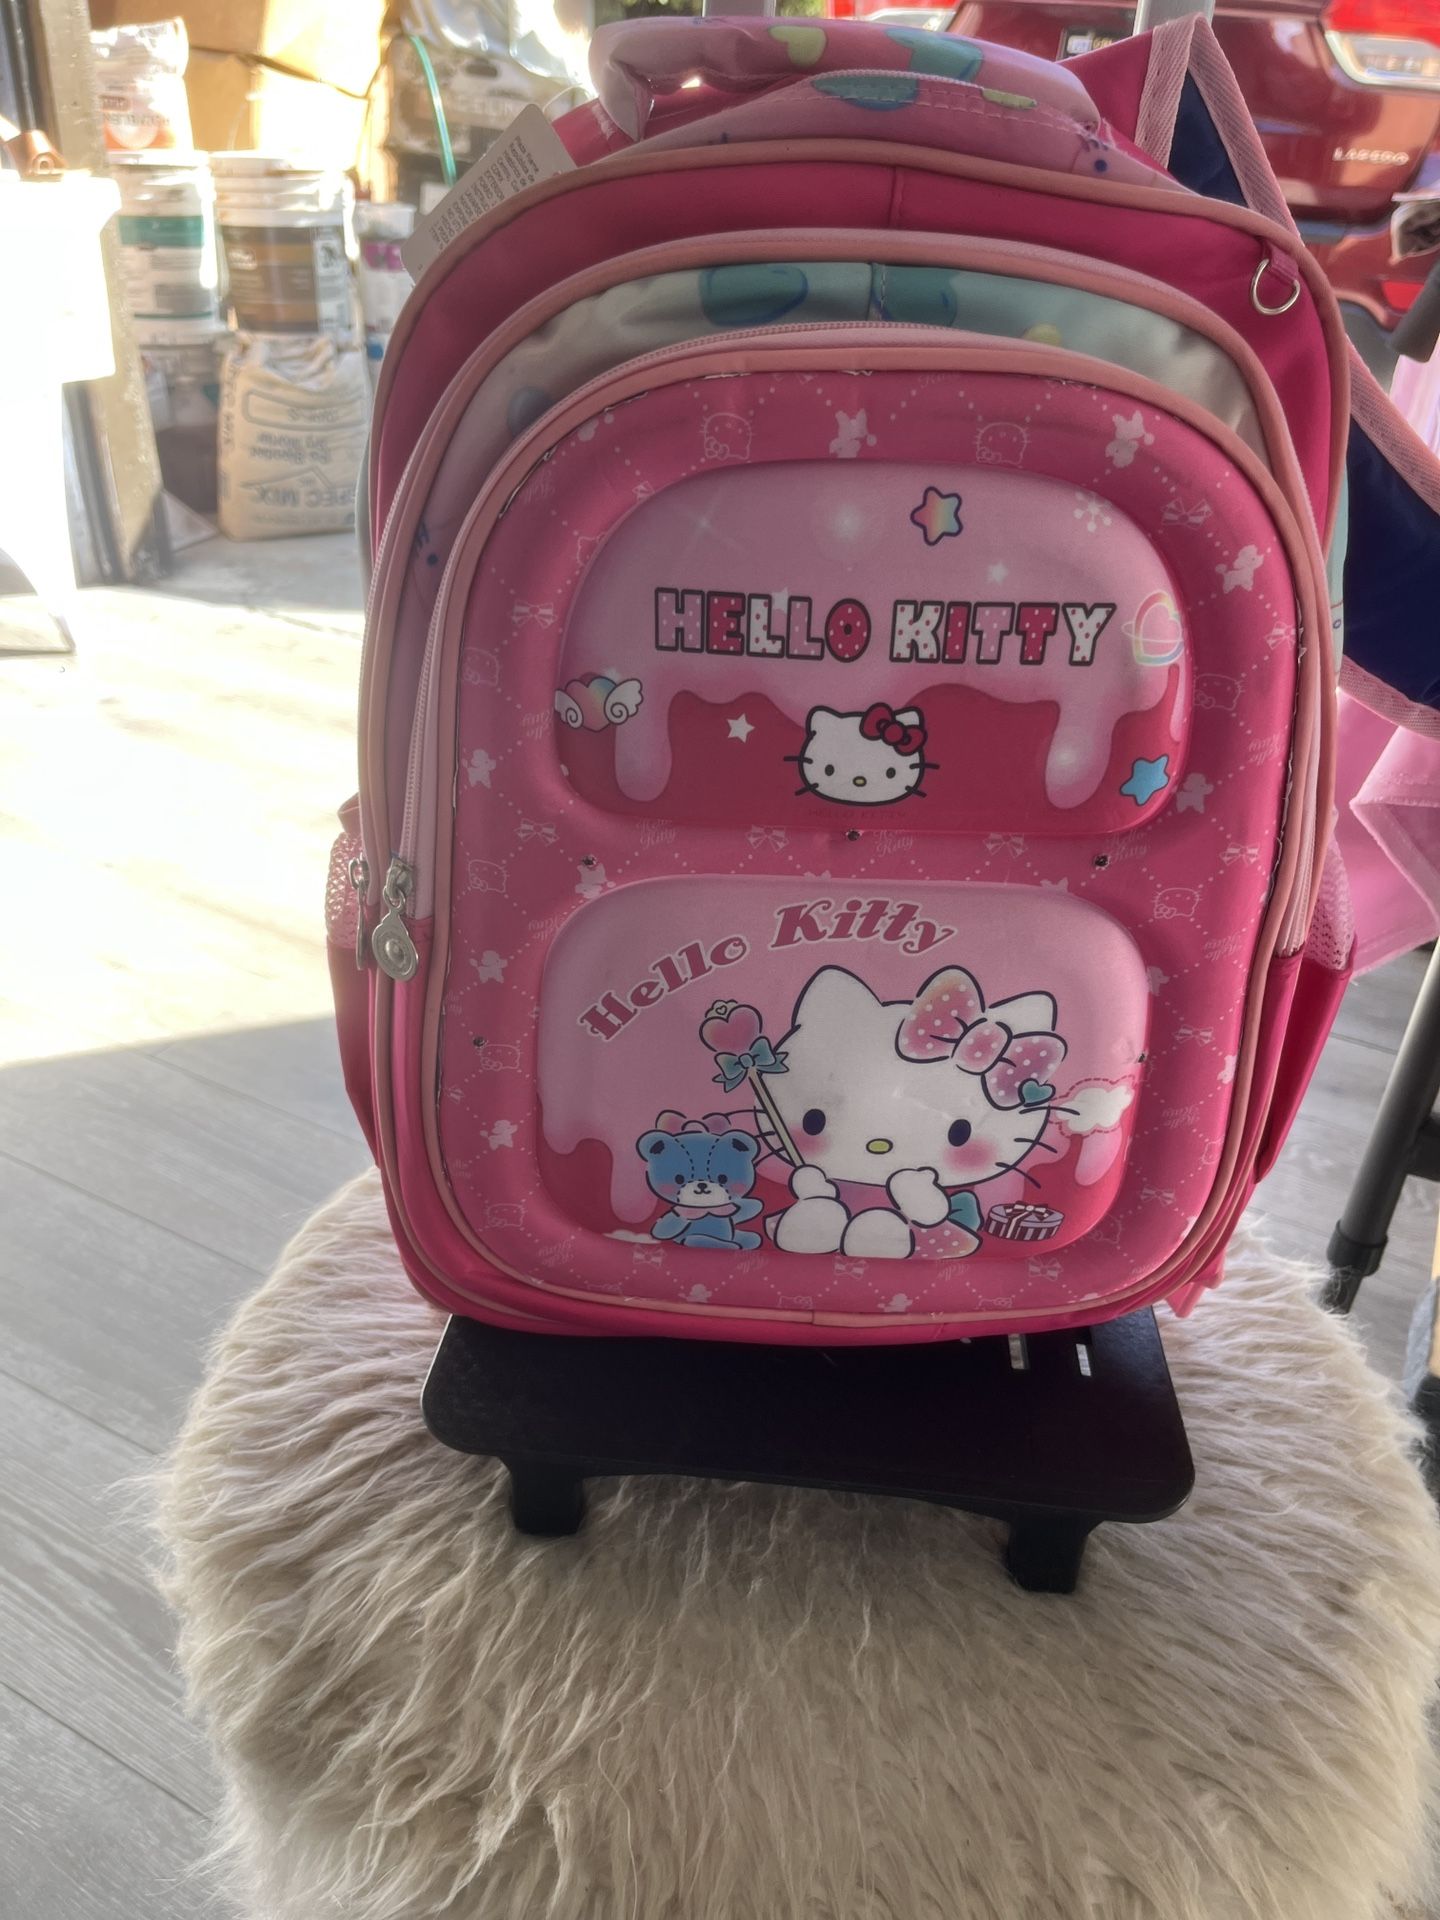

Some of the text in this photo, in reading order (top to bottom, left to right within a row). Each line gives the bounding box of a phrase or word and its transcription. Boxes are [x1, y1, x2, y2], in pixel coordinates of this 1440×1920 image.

[655, 587, 1117, 666] HELLO KITTY
[579, 898, 955, 1041] Hello Kitty
